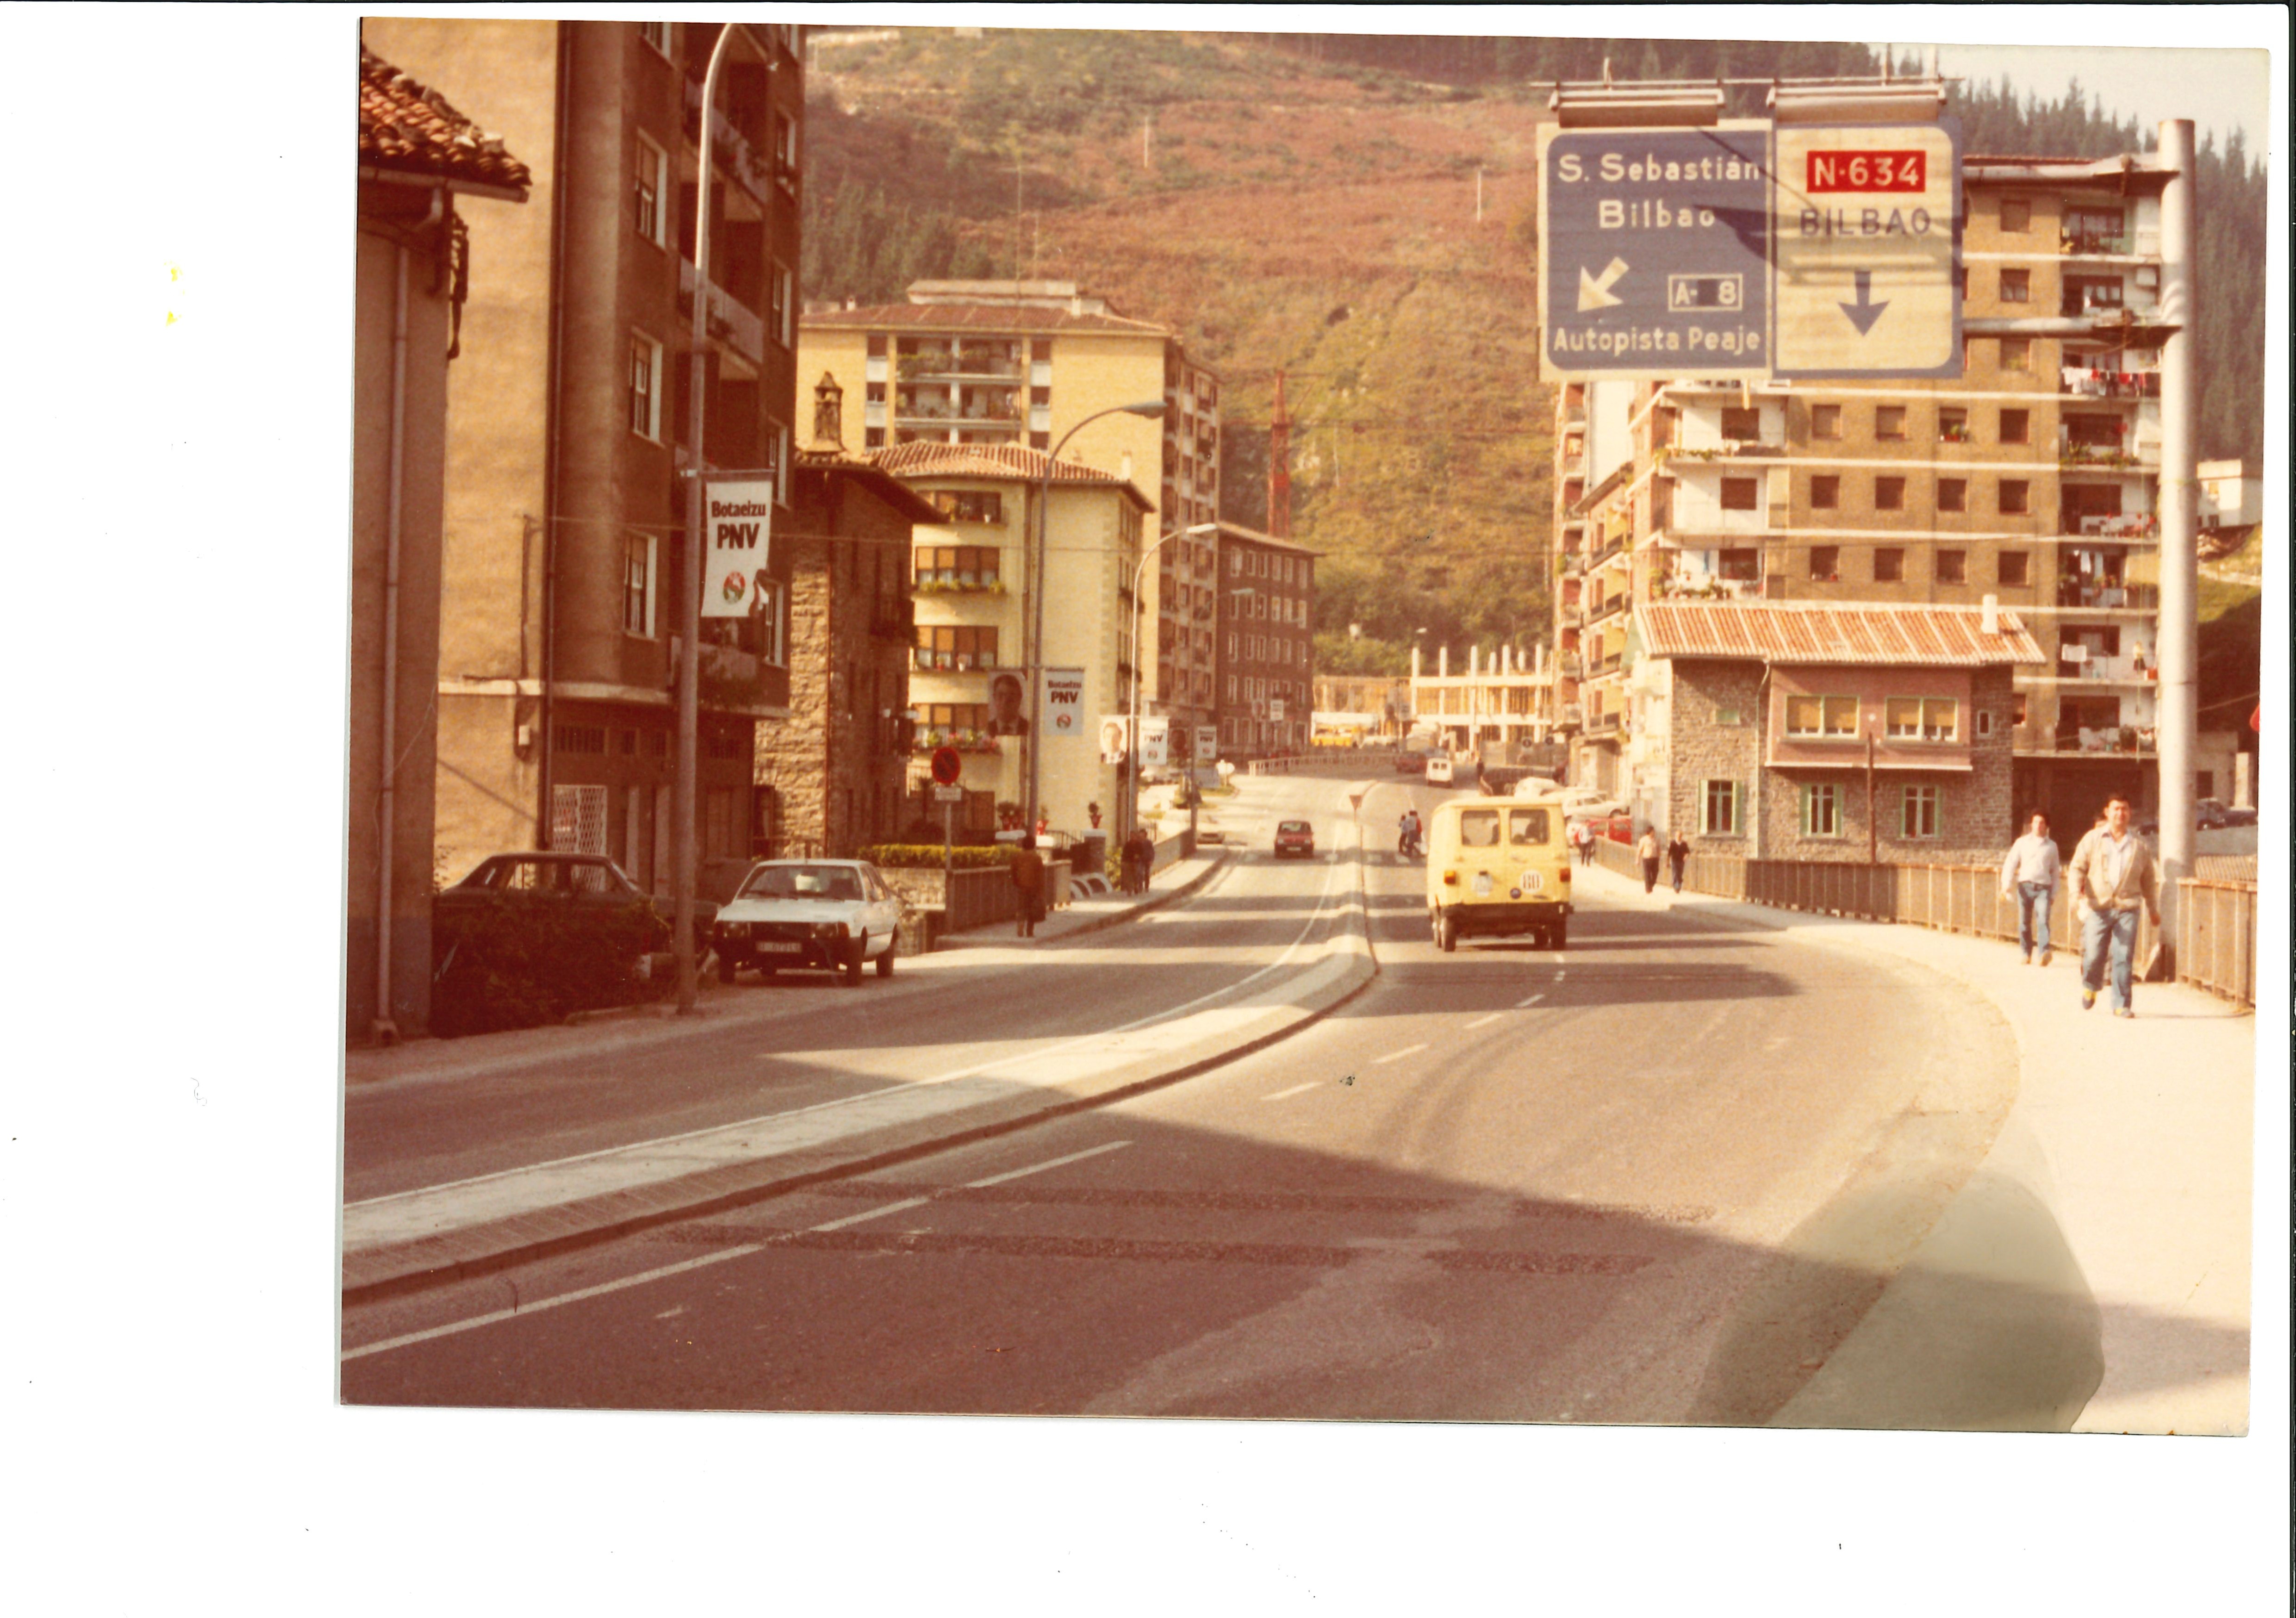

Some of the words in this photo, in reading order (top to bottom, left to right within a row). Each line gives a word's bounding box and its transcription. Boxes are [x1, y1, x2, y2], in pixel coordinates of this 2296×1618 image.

[1558, 154, 1589, 182] S.
[1600, 153, 1759, 181] Sebastián
[1815, 156, 1918, 186] N-634
[1599, 199, 1715, 228] Bilbao
[1800, 208, 1930, 235] BILBAO
[1554, 327, 1680, 357] Autopista
[1688, 325, 1760, 355] Peaje
[711, 500, 766, 518] Botaeizu
[717, 523, 760, 549] PNV
[1051, 691, 1078, 704] PNV
